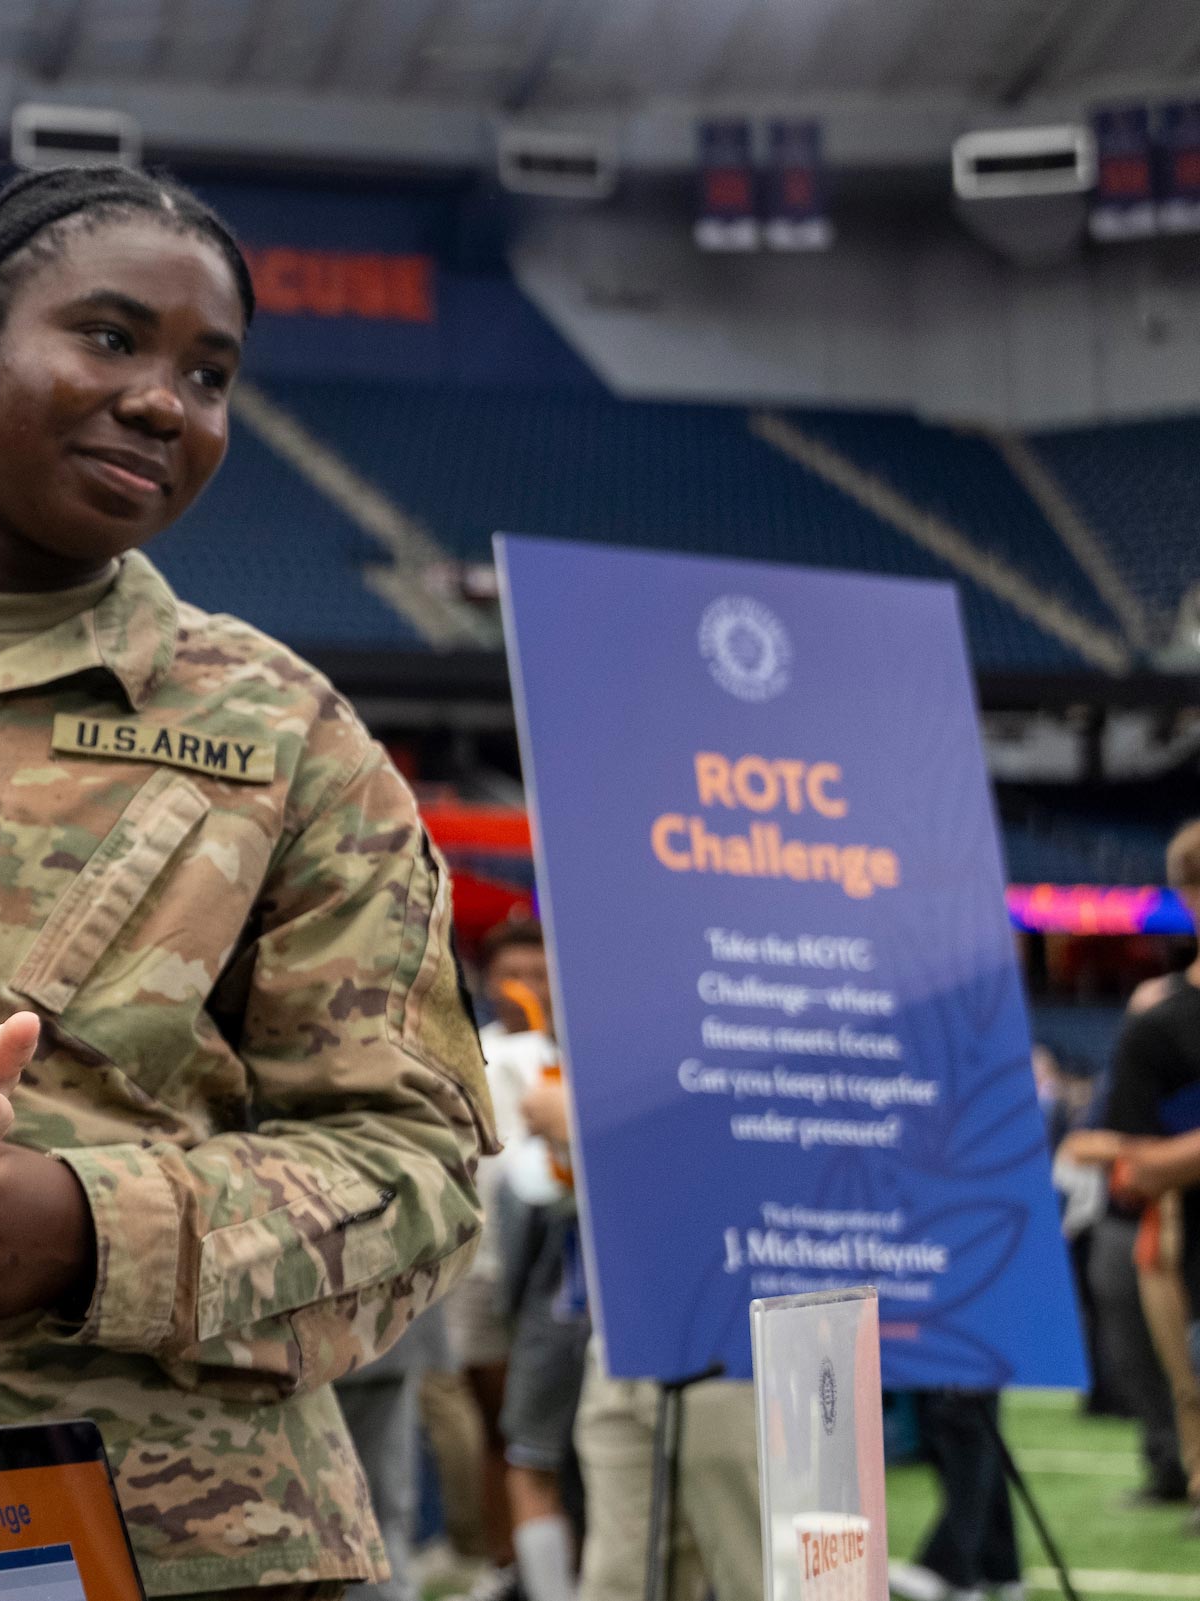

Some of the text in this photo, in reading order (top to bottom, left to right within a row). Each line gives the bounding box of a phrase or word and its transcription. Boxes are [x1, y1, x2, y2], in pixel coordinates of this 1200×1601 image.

[694, 751, 848, 820] ROTC
[651, 812, 901, 899] Challenge
[704, 926, 875, 972] Take the ROTC
[747, 1226, 851, 1271] Michael
[801, 1525, 865, 1580] Take the
